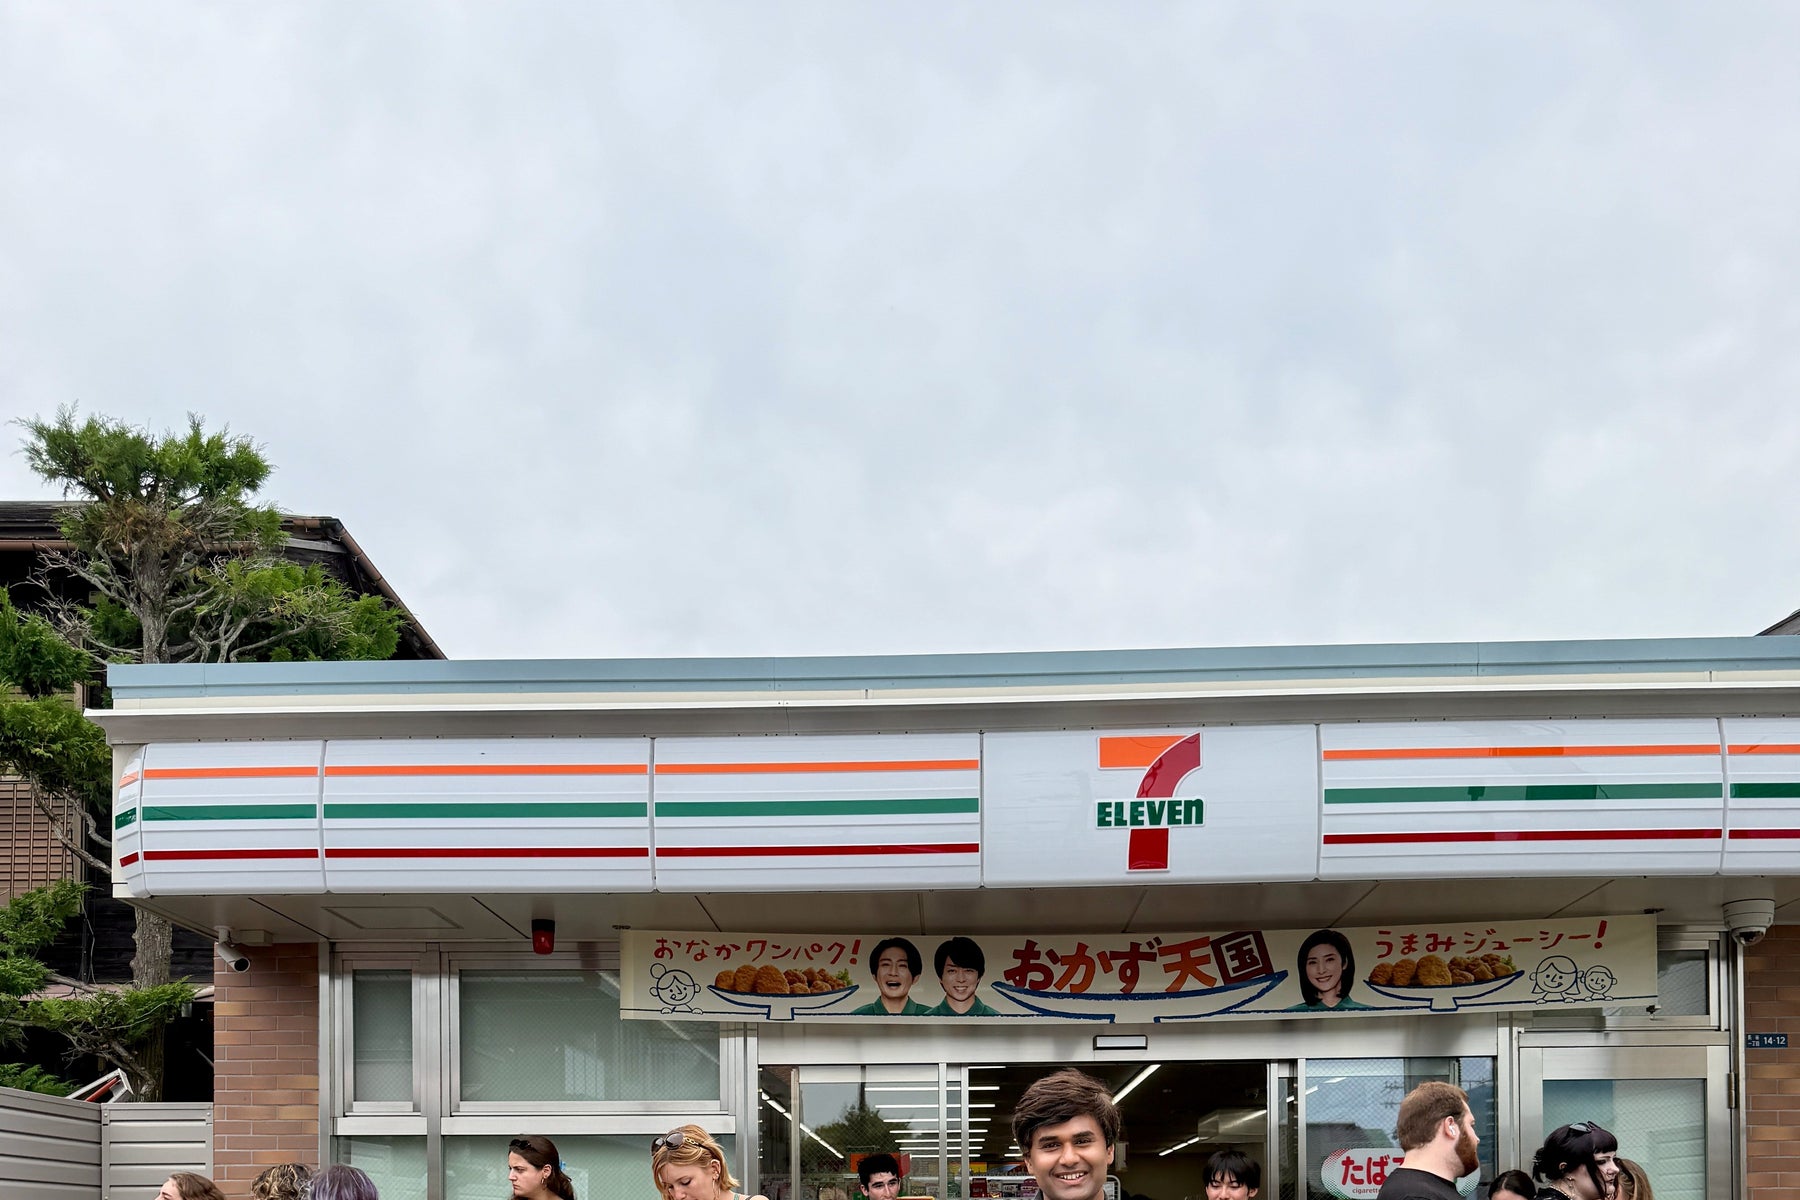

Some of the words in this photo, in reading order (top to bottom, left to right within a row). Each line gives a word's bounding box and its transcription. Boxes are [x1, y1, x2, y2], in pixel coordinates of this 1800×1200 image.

[1003, 930, 1275, 994] おかず天国
